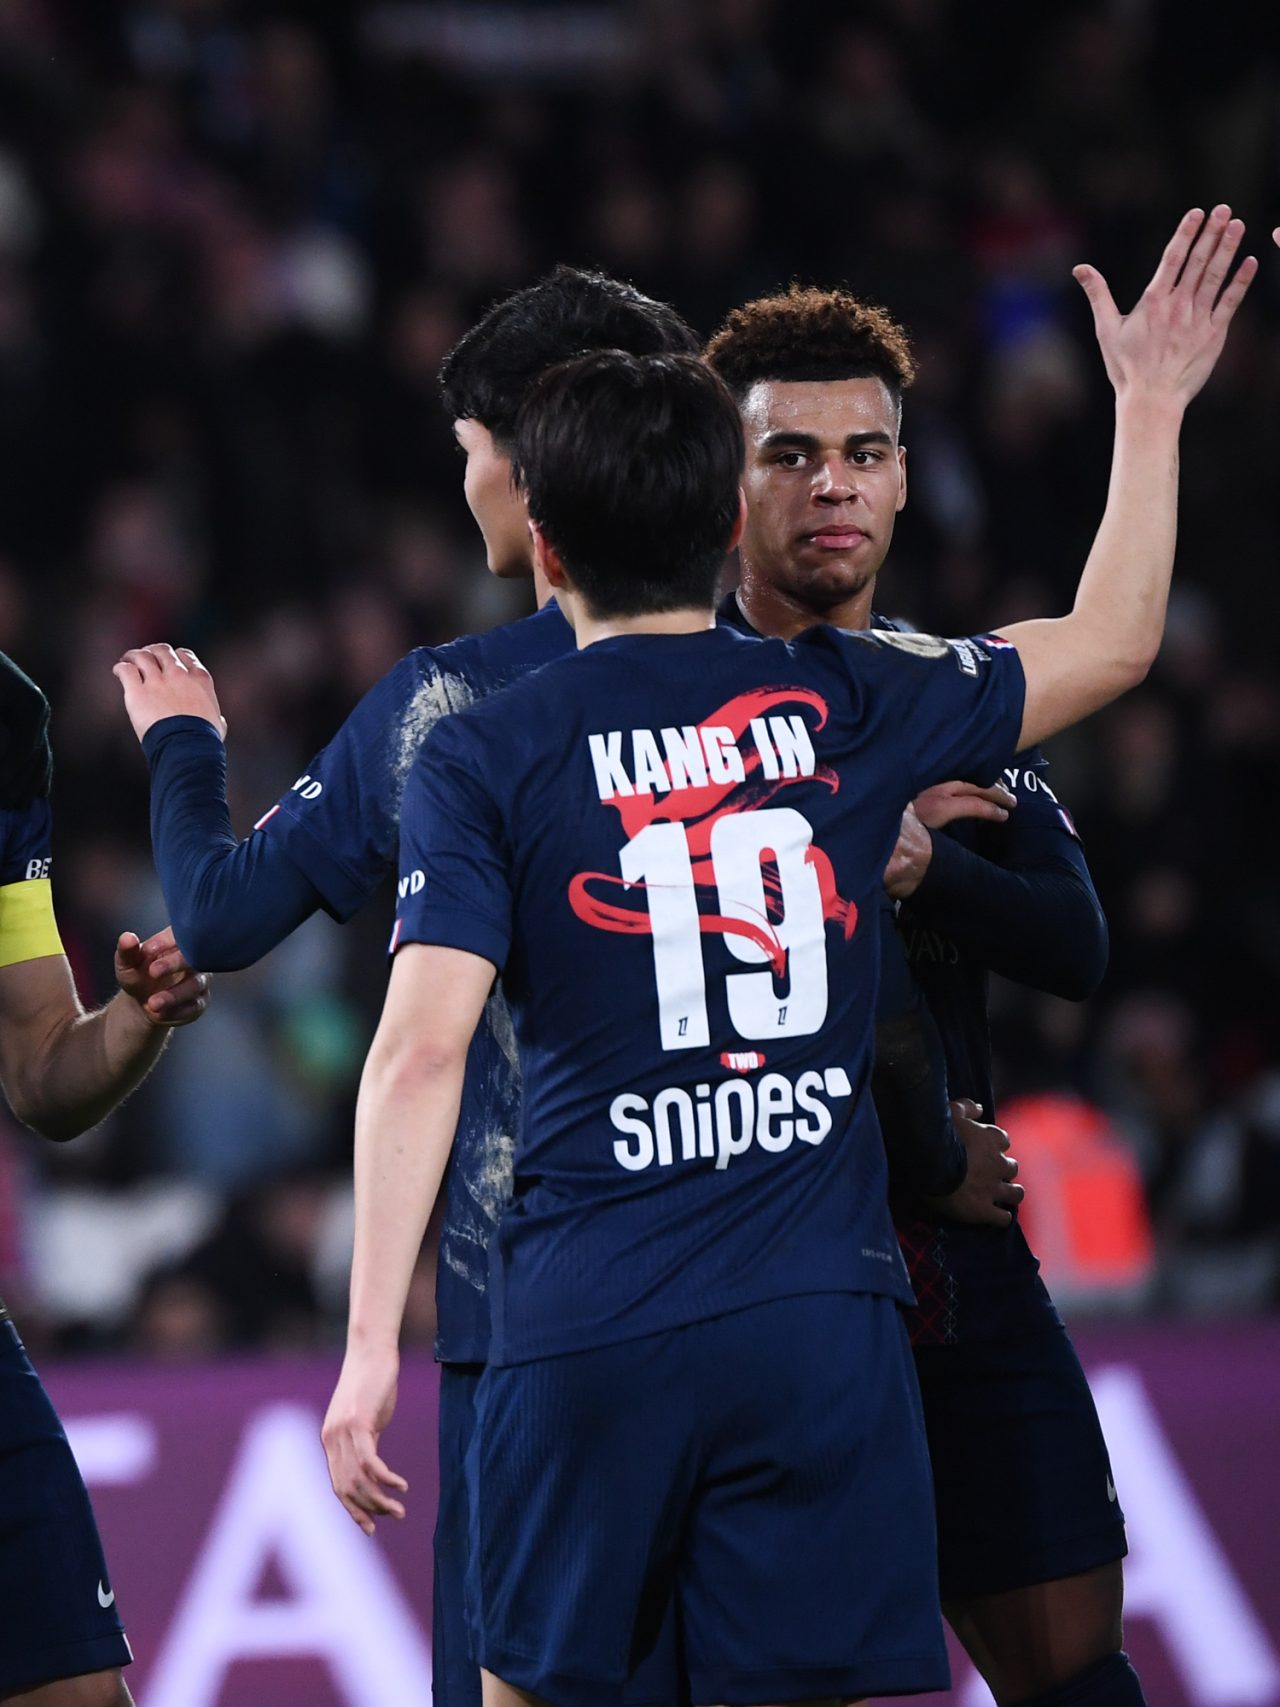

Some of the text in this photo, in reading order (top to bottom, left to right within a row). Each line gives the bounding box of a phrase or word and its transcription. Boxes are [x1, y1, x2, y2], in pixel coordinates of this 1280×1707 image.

[588, 715, 816, 800] KANG IN
[618, 807, 829, 1051] 19
[609, 1070, 833, 1171] snipes
